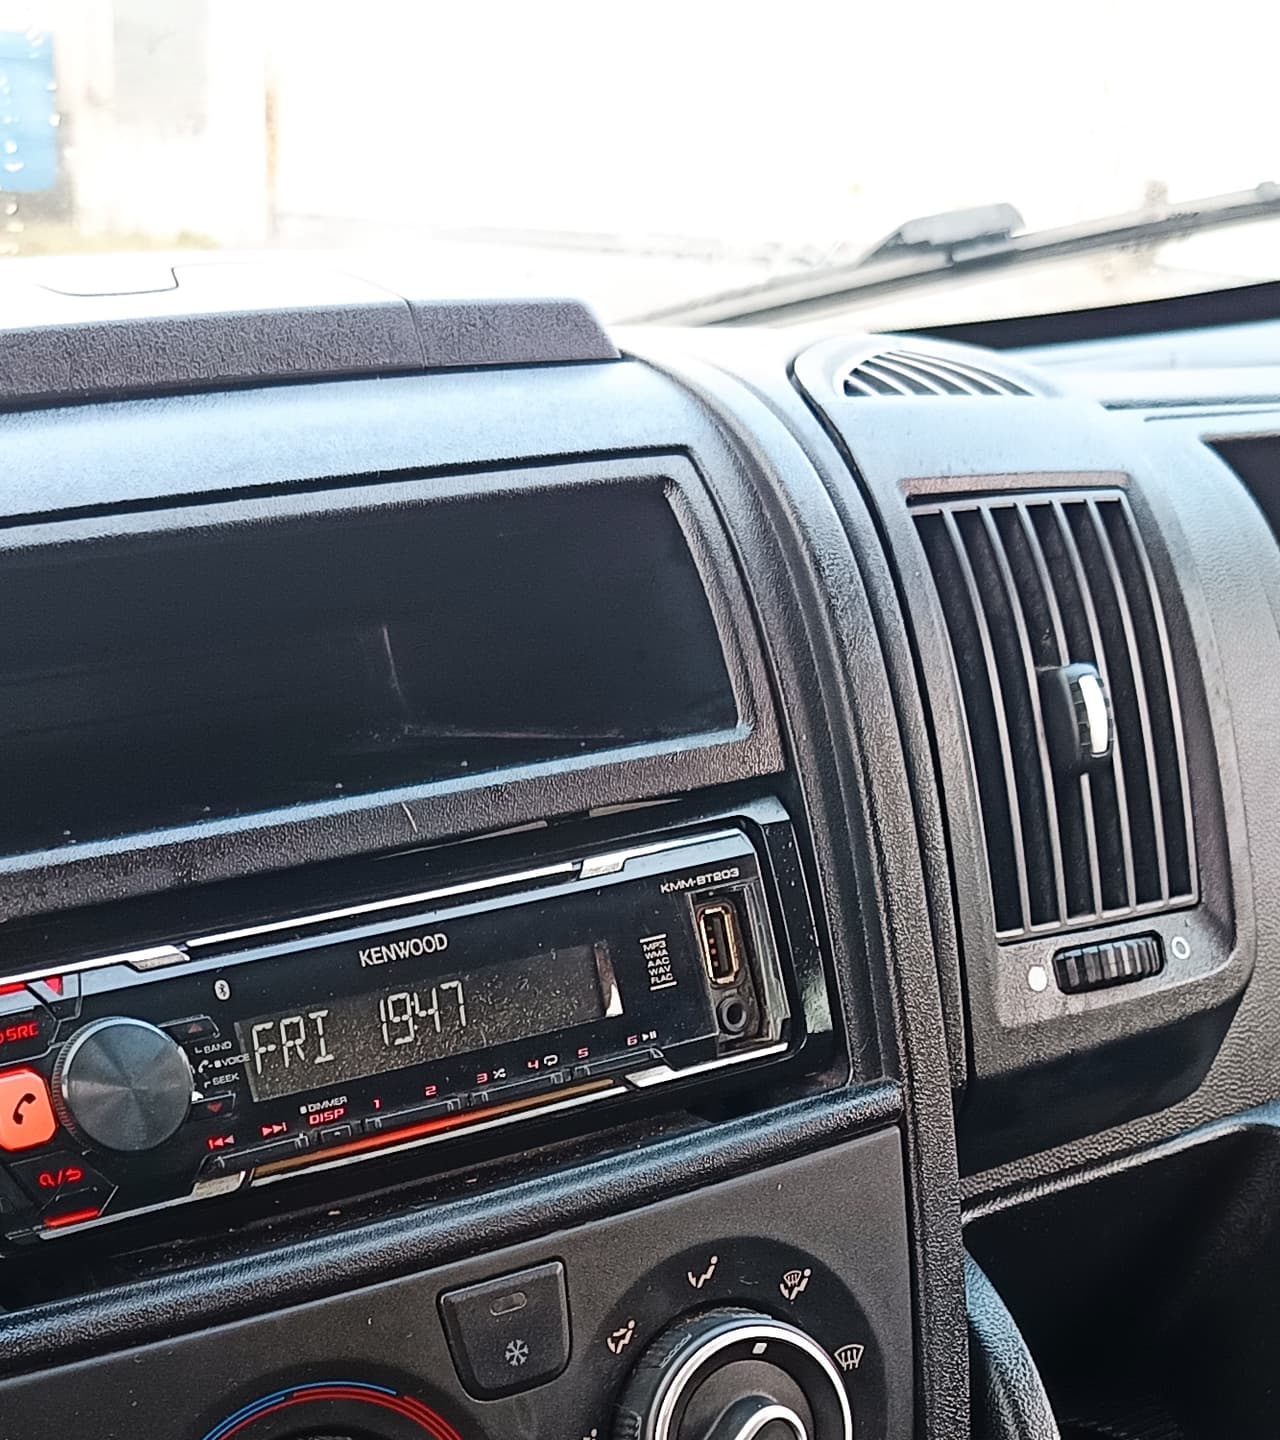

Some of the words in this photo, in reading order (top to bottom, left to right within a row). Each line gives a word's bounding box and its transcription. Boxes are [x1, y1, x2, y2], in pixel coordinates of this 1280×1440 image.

[660, 867, 740, 893] KMM-BT203
[359, 933, 448, 967] KENWOOD
[643, 940, 666, 952] MP3
[644, 950, 669, 960] WMA
[647, 957, 670, 968] AAC
[648, 965, 671, 976] WAV
[650, 974, 673, 984] FLAC
[6, 1021, 39, 1042] SRC
[251, 1009, 334, 1074] FRI
[627, 1035, 638, 1046] 6
[203, 1040, 232, 1054] BAND
[577, 1048, 589, 1058] 5
[222, 1053, 251, 1068] VOICE
[528, 1059, 539, 1070] 4
[212, 1072, 240, 1086] SEEK
[476, 1073, 488, 1084] 3
[424, 1085, 438, 1097] 2
[308, 1095, 348, 1112] DIMMER
[373, 1098, 382, 1109] 1
[309, 1108, 345, 1125] DISP
